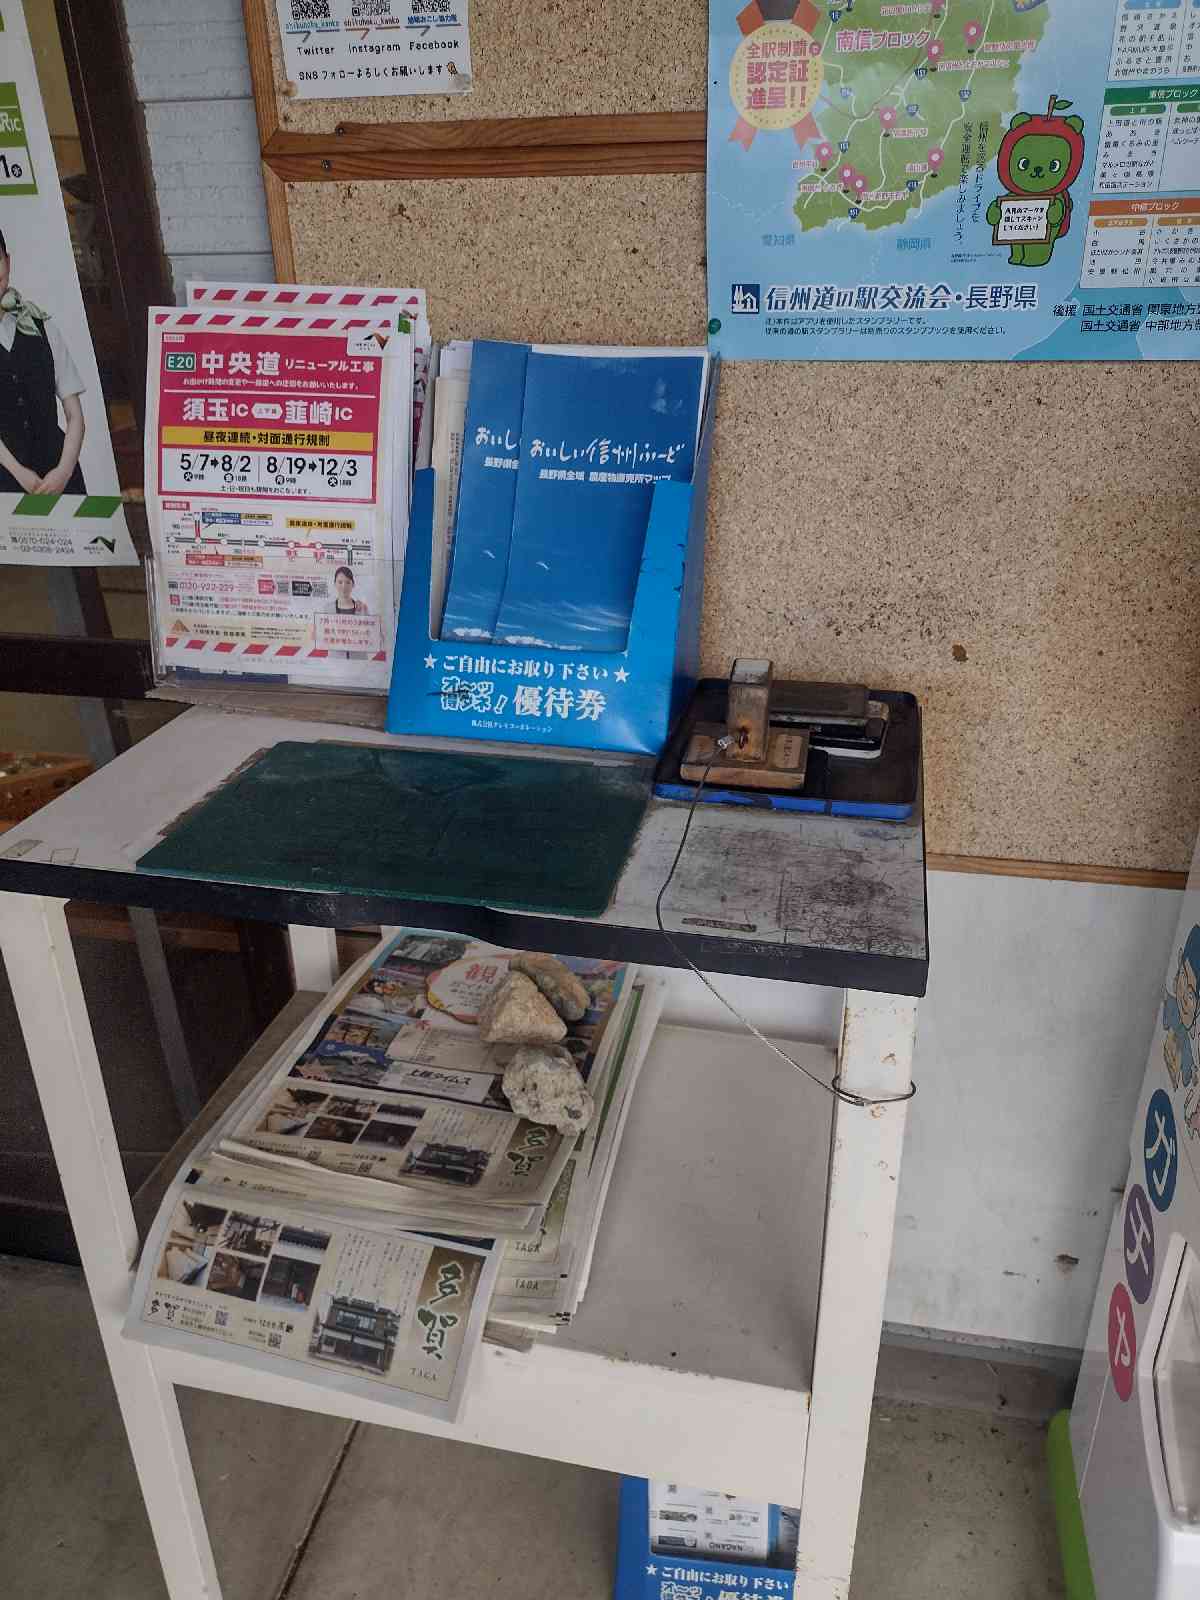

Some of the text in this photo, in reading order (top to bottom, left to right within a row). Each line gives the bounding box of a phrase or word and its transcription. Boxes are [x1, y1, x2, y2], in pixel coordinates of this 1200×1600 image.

[298, 40, 460, 56] Twitter Instagram Facebook
[836, 30, 930, 51] 南信ブロック
[747, 60, 809, 85] 認定証
[766, 284, 1037, 310] 信州道の駅交流会・長野県
[1053, 304, 1077, 317] 後援
[1082, 304, 1142, 316] 国土交通省
[1080, 320, 1140, 333] 国土交通省
[167, 350, 375, 375] E20 中央道 リニューアル工事
[183, 397, 248, 421] 須玉IC
[285, 400, 352, 425] 韮崎IC
[203, 431, 330, 446] 昼夜連続・対面通行規制
[180, 453, 251, 473] 5/7 8/2
[266, 456, 357, 477] 8/19 12/3
[443, 654, 609, 681] ご自由にお取り下さい
[513, 684, 607, 721] 優待券
[661, 1565, 789, 1590] ご自由にお取り下さい
